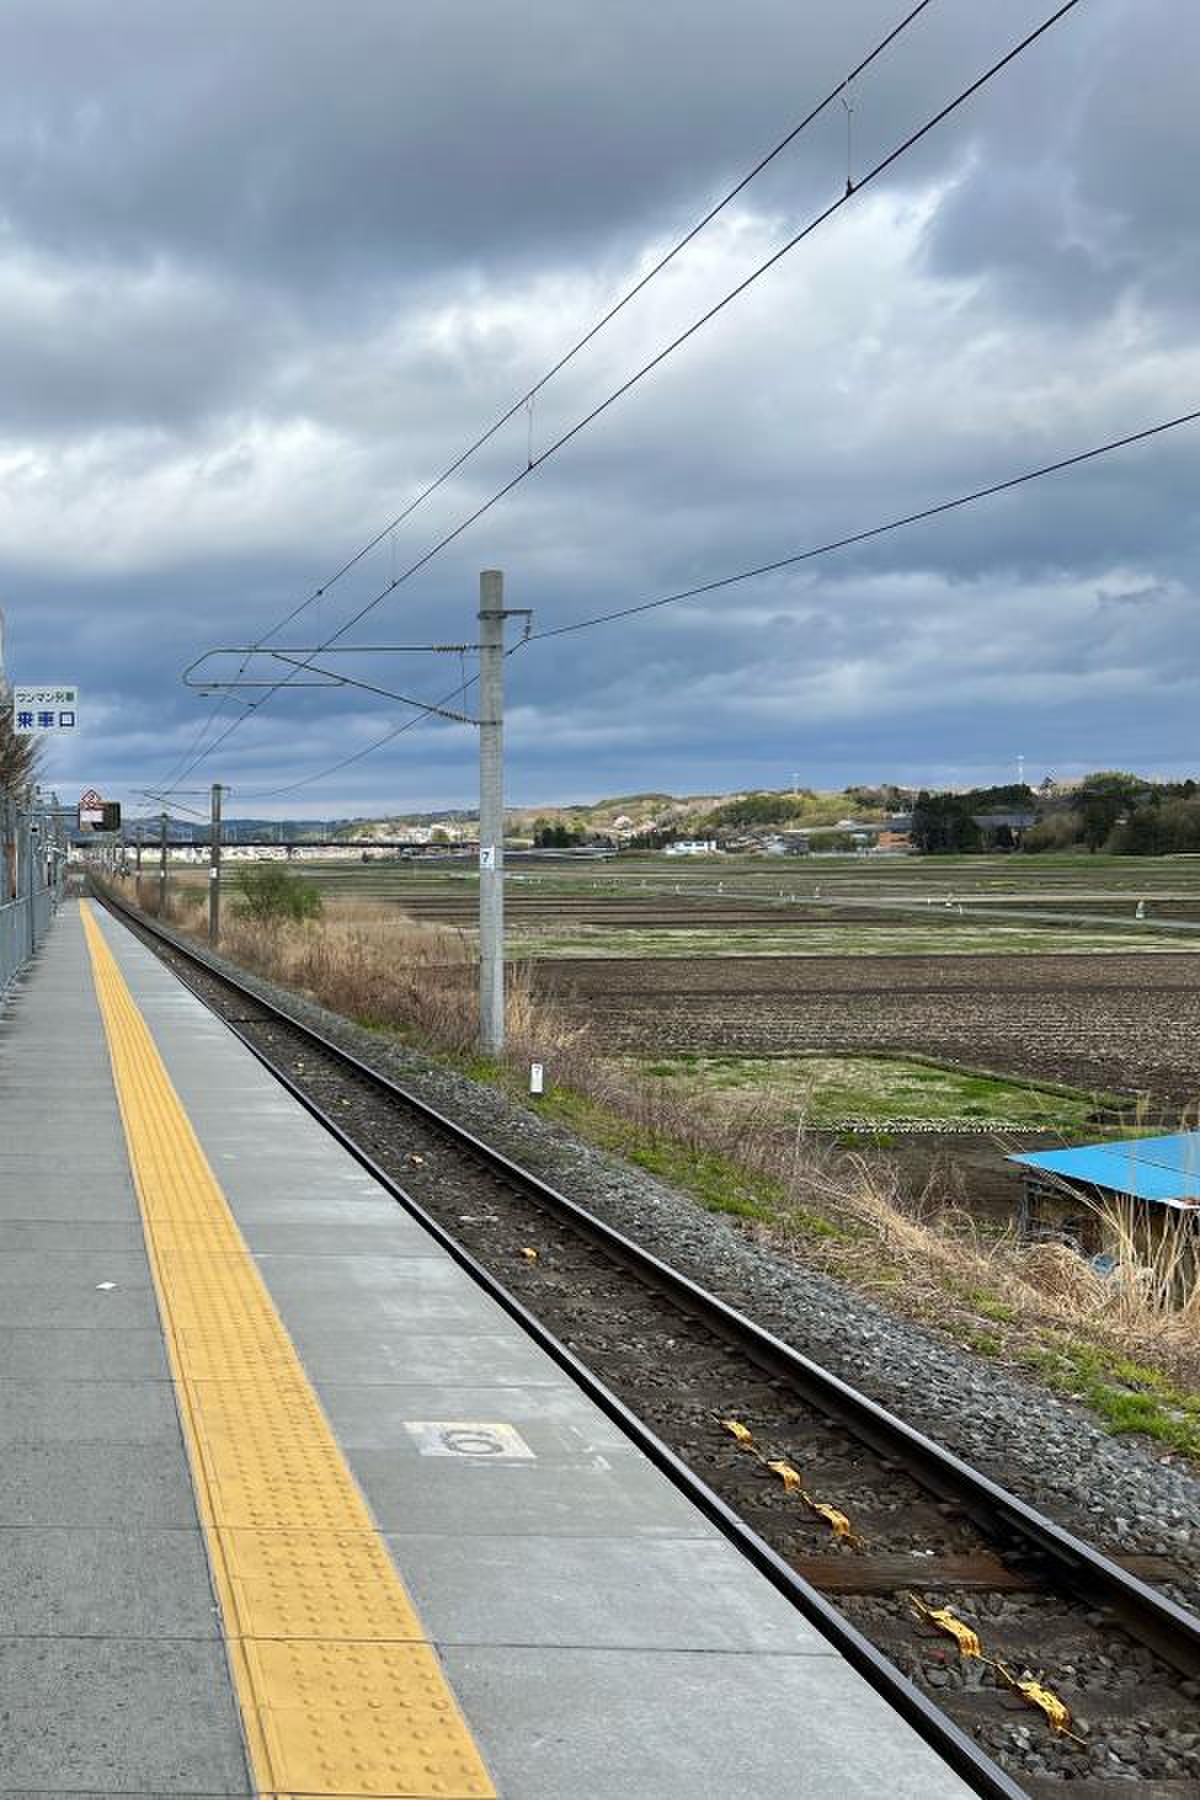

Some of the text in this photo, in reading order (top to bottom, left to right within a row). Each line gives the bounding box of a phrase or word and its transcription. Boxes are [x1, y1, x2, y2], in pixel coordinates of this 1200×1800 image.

[17, 710, 75, 727] 乗車口
[482, 851, 490, 863] 7
